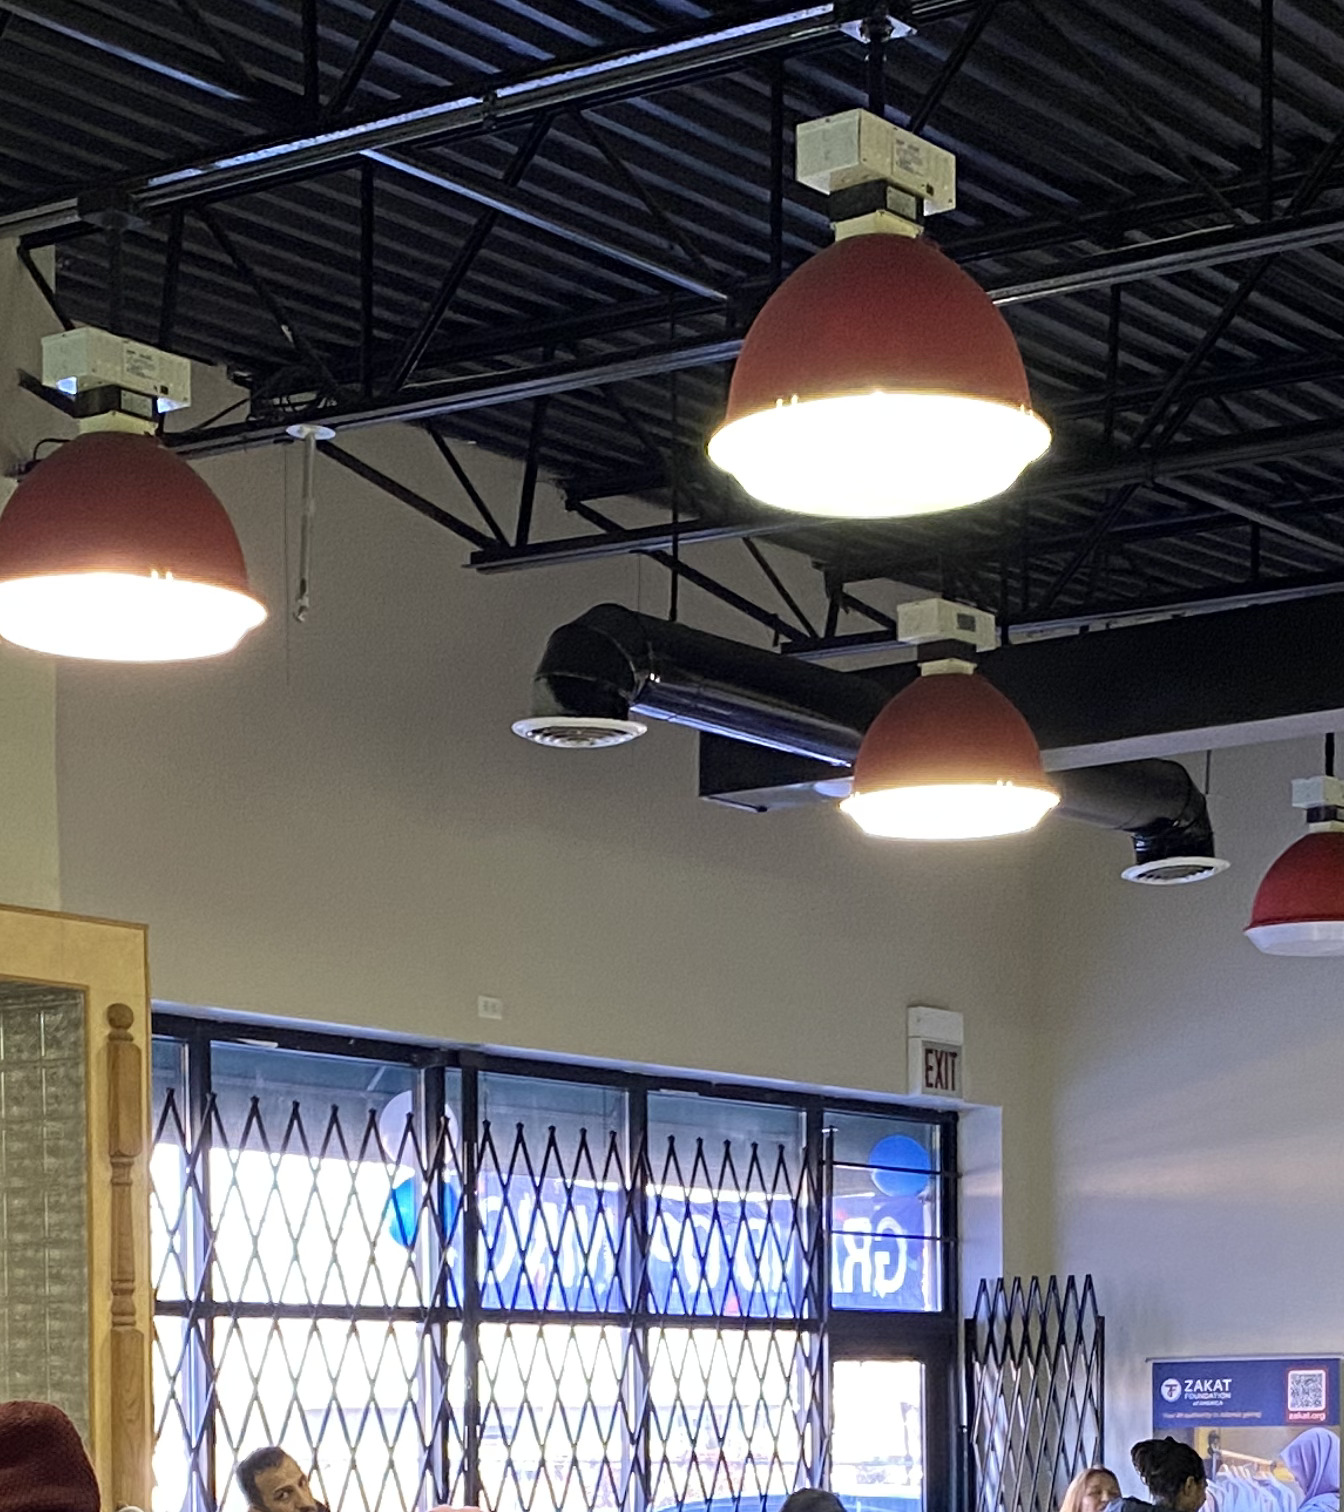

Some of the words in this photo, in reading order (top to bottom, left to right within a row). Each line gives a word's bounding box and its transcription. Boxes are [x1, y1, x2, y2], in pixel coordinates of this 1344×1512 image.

[924, 1048, 958, 1092] EXIT
[1184, 1378, 1233, 1393] ZAKAT
[1184, 1392, 1232, 1400] FOUNDATION
